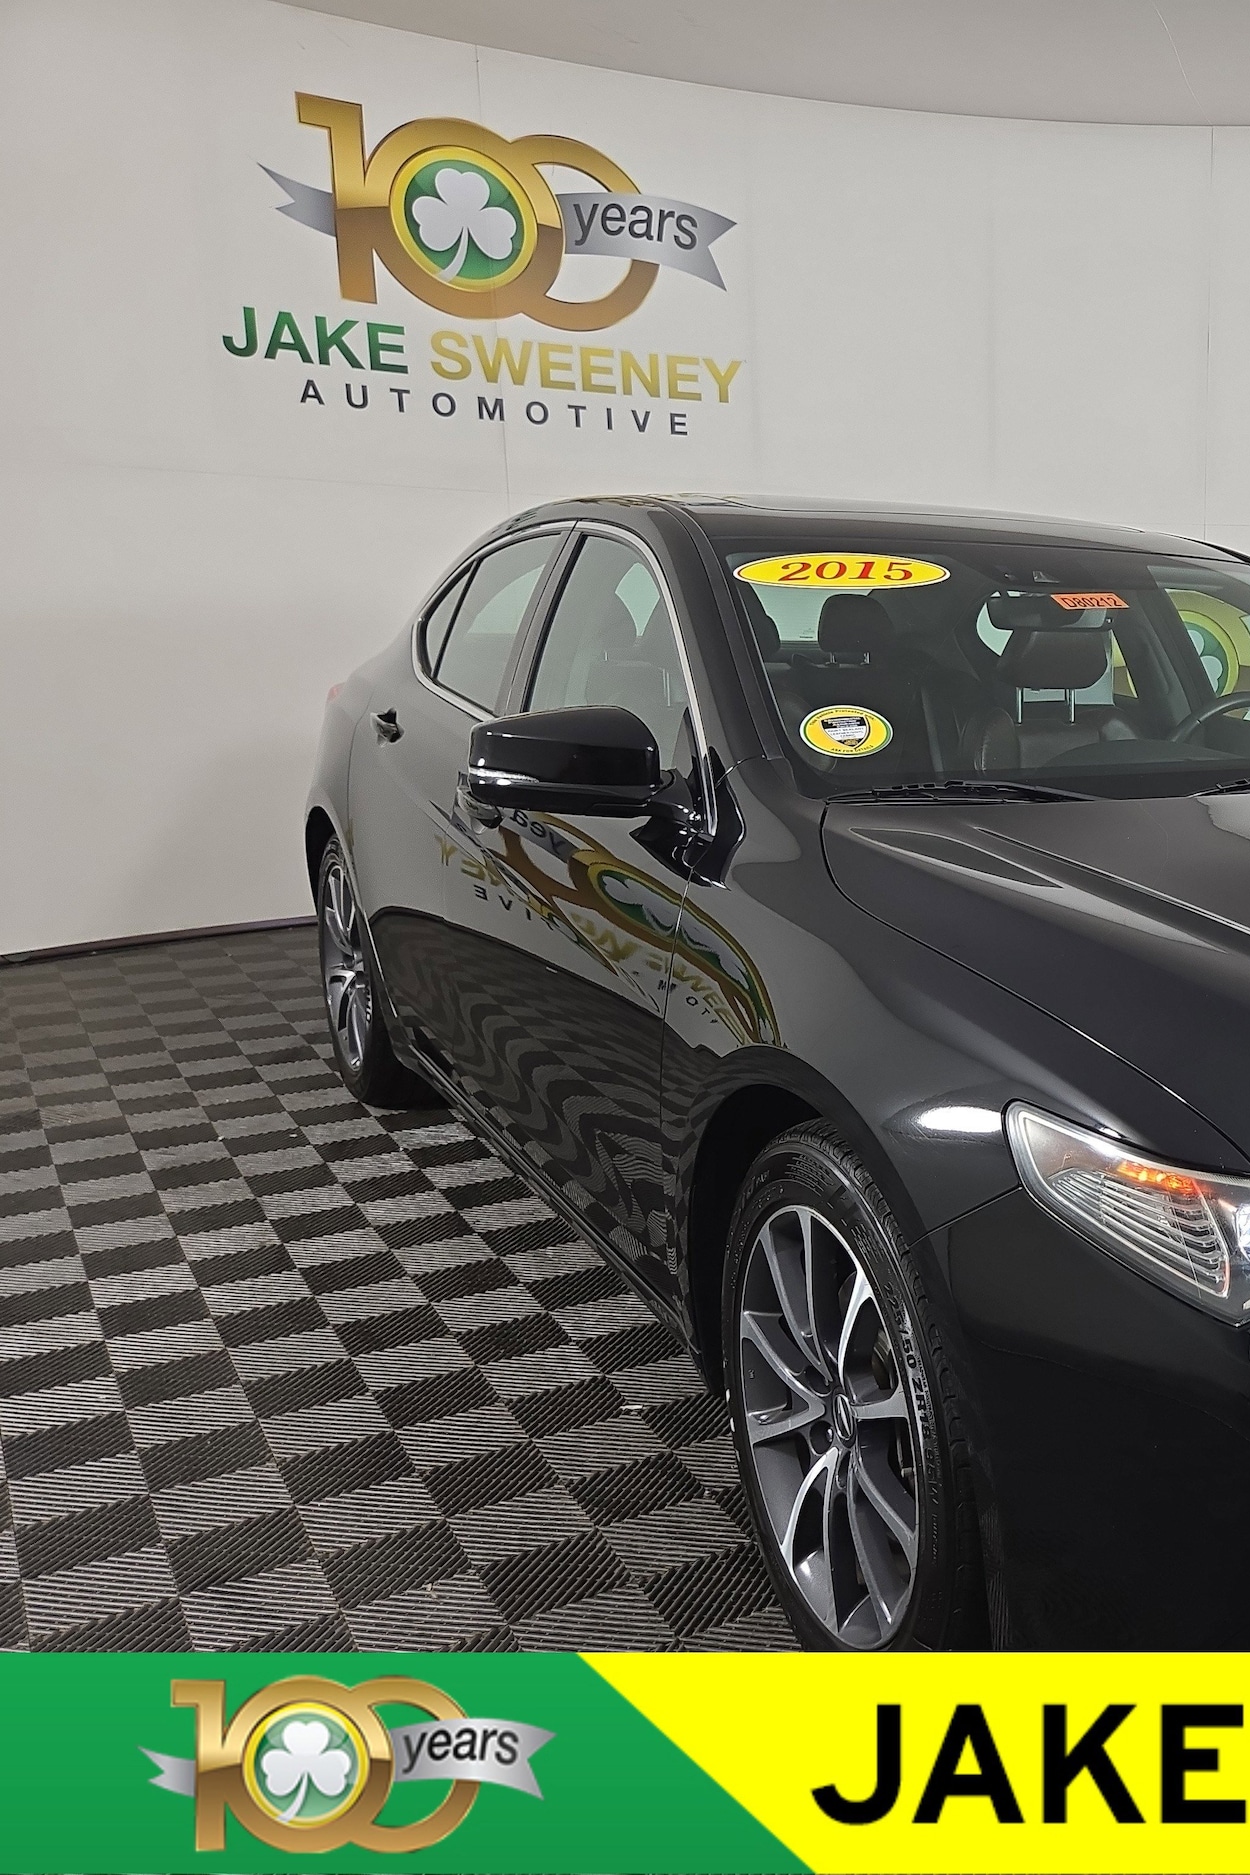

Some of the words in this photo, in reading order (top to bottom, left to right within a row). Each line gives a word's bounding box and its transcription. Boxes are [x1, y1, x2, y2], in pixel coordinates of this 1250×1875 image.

[295, 91, 660, 332] 100
[573, 201, 699, 250] years
[222, 306, 409, 374] JAKE
[430, 330, 743, 404] SWEENEY
[301, 379, 689, 436] AUTOMOTIVE
[777, 560, 913, 582] 2015
[1060, 597, 1123, 608] D80212
